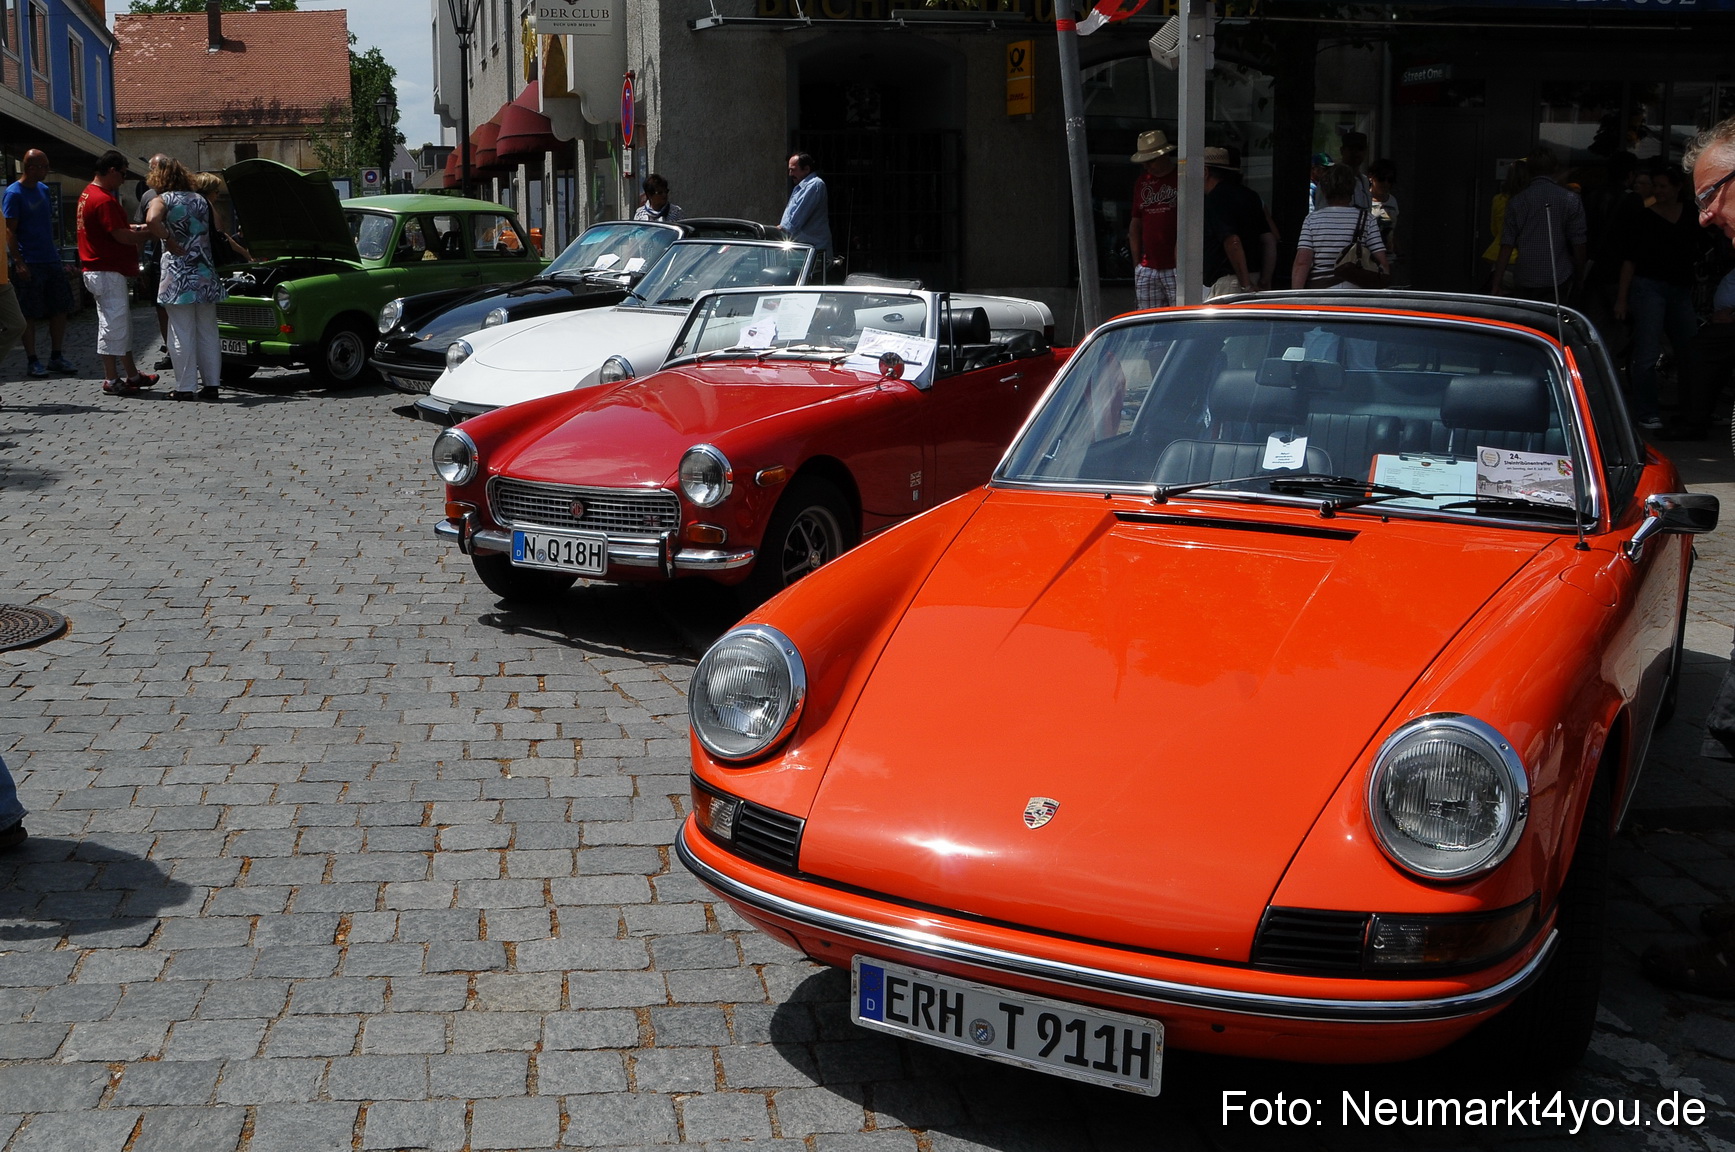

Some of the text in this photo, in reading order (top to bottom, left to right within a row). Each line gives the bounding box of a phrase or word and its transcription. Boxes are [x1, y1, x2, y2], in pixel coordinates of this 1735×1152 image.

[540, 8, 610, 19] DER CLUB
[1403, 68, 1443, 83] Street One
[228, 340, 242, 353] 601
[517, 549, 522, 557] D
[524, 536, 536, 560] N
[866, 997, 876, 1011] D
[886, 975, 1151, 1080] ERH T 911H
